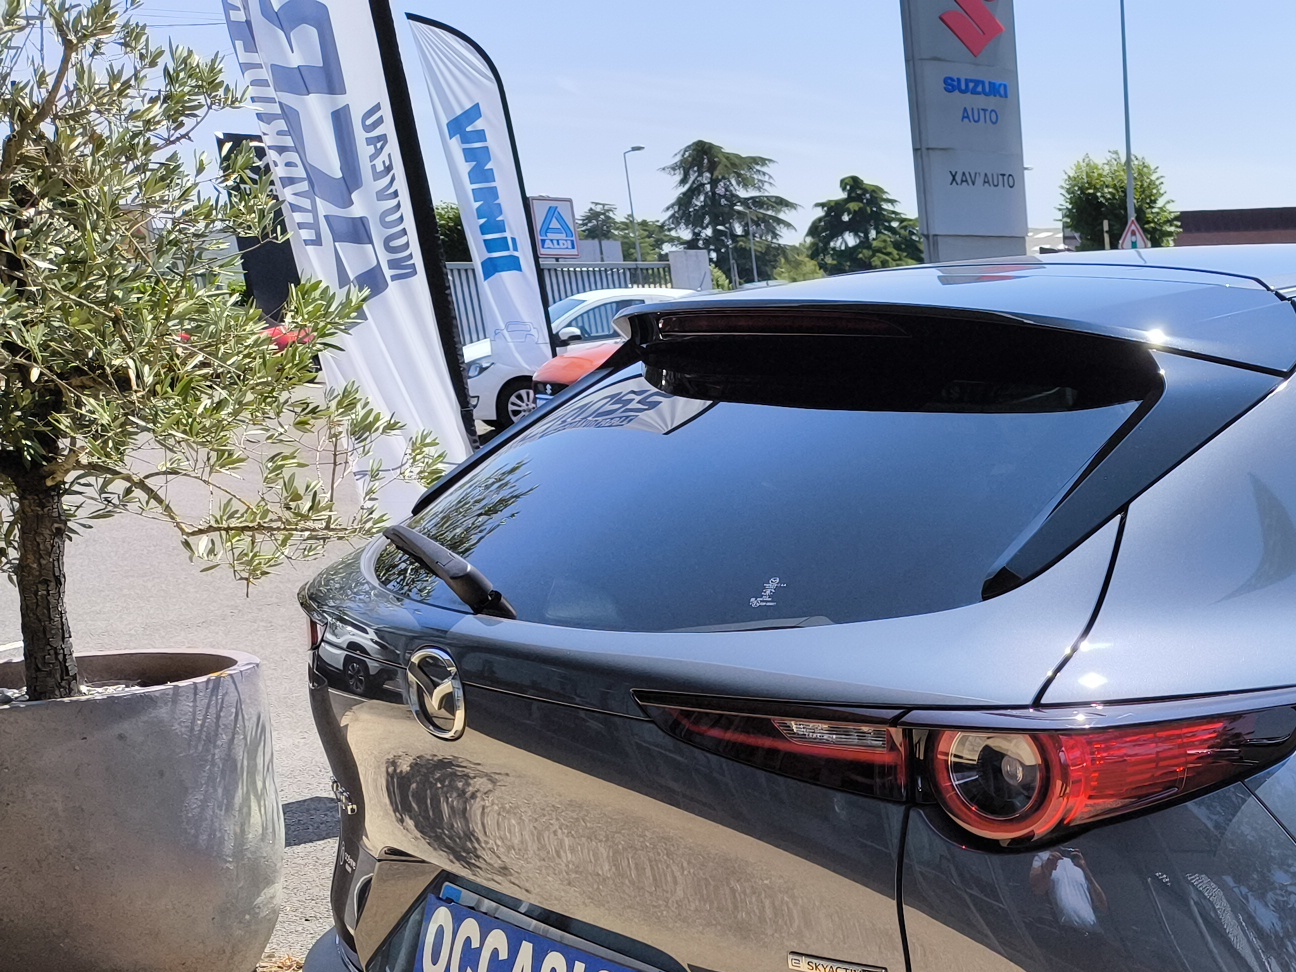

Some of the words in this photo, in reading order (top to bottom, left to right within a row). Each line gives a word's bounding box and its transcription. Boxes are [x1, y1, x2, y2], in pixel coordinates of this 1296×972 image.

[943, 76, 1009, 98] SUZUKI
[961, 106, 999, 125] AUTO
[543, 239, 572, 249] ALDI
